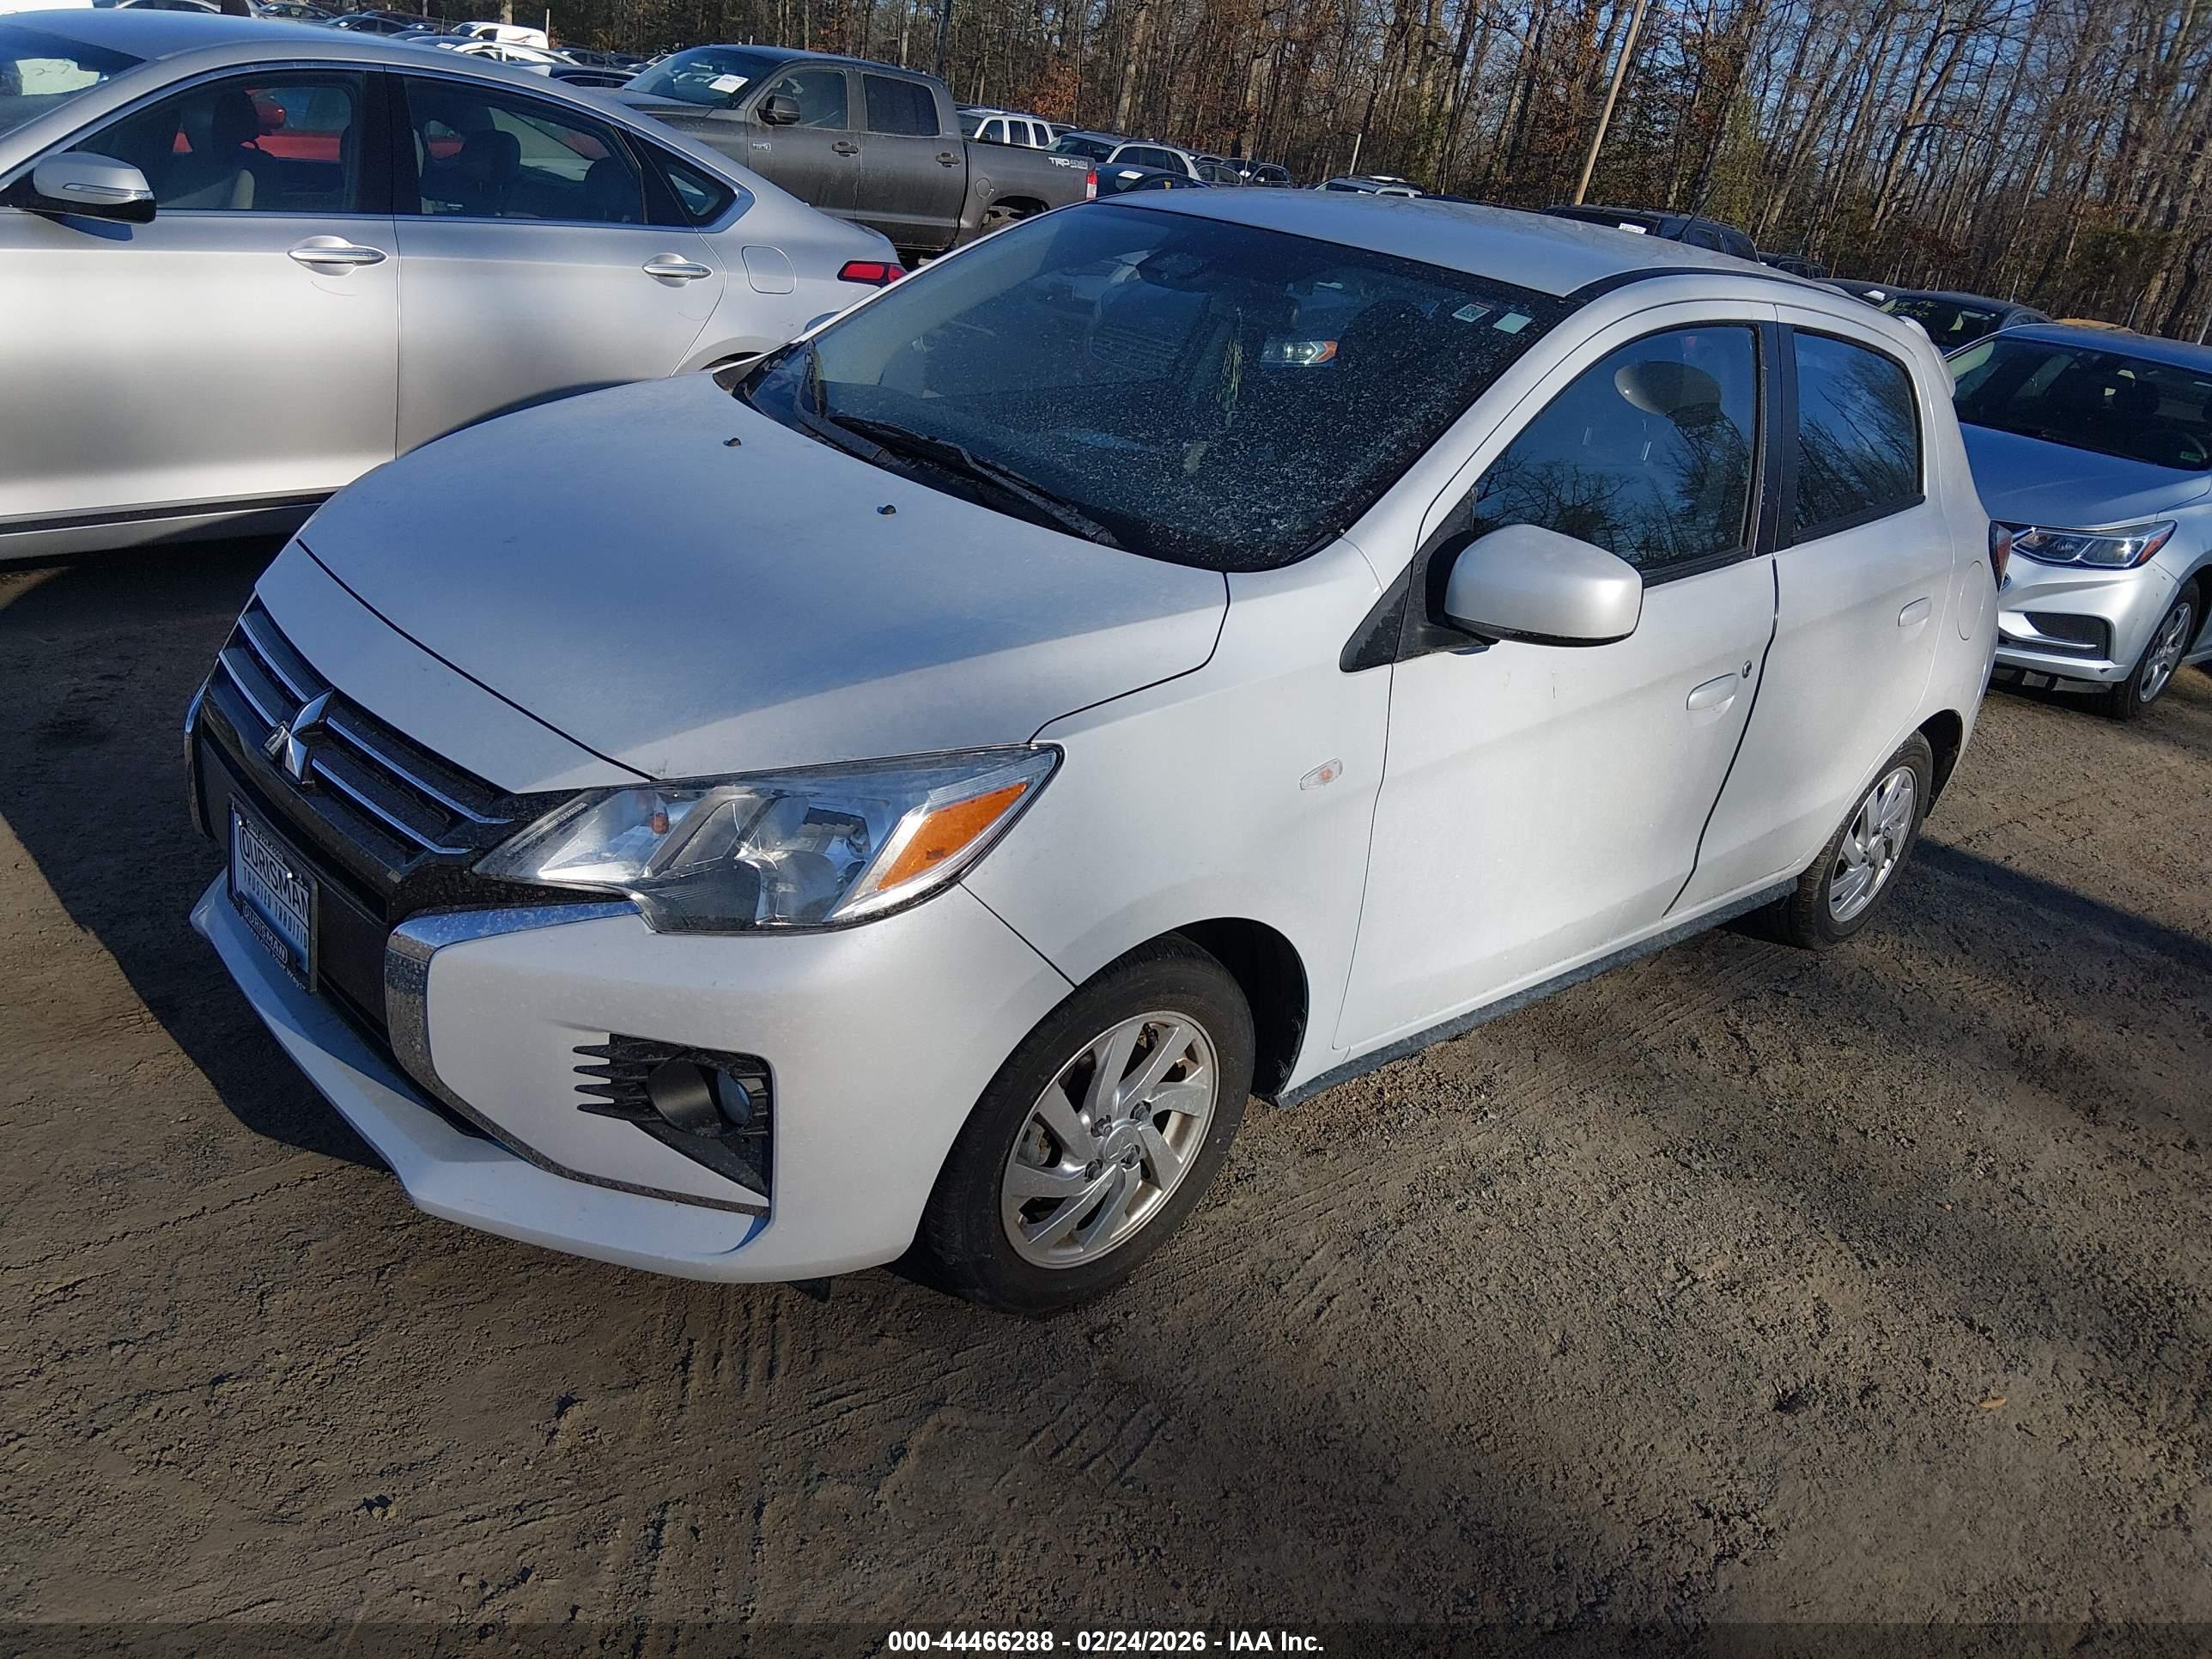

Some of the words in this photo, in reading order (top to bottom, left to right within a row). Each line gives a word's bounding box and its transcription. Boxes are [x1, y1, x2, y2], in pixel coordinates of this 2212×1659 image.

[1048, 156, 1070, 167] TRD
[241, 830, 309, 920] OURISMAN
[243, 866, 271, 910] TRUSTED
[243, 904, 286, 963] OURISMAN
